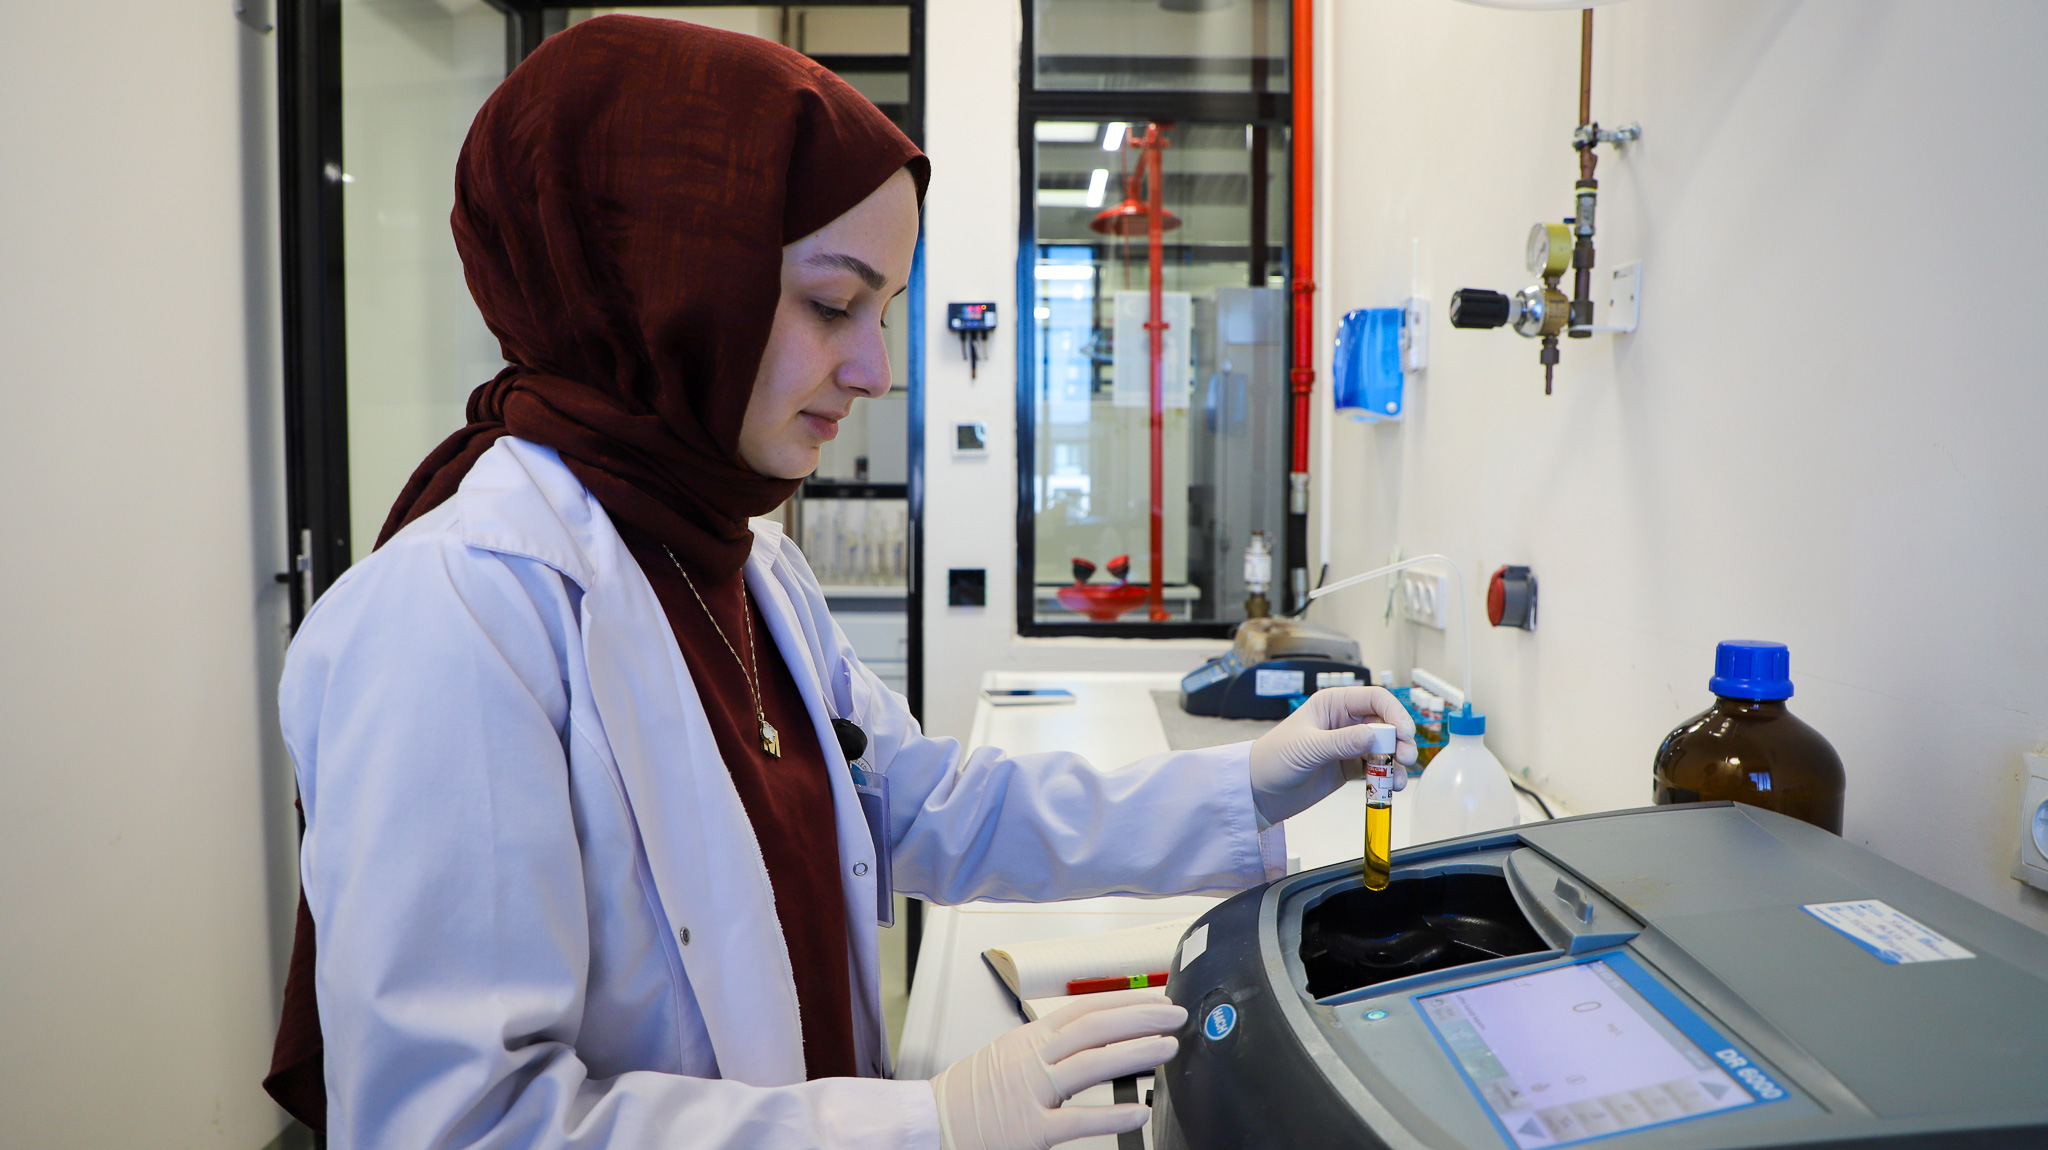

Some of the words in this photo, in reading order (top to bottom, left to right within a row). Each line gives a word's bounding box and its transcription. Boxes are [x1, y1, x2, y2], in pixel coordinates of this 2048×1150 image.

[1213, 1008, 1228, 1033] HACH
[1715, 1048, 1748, 1069] DR
[1737, 1067, 1783, 1099] 6000
